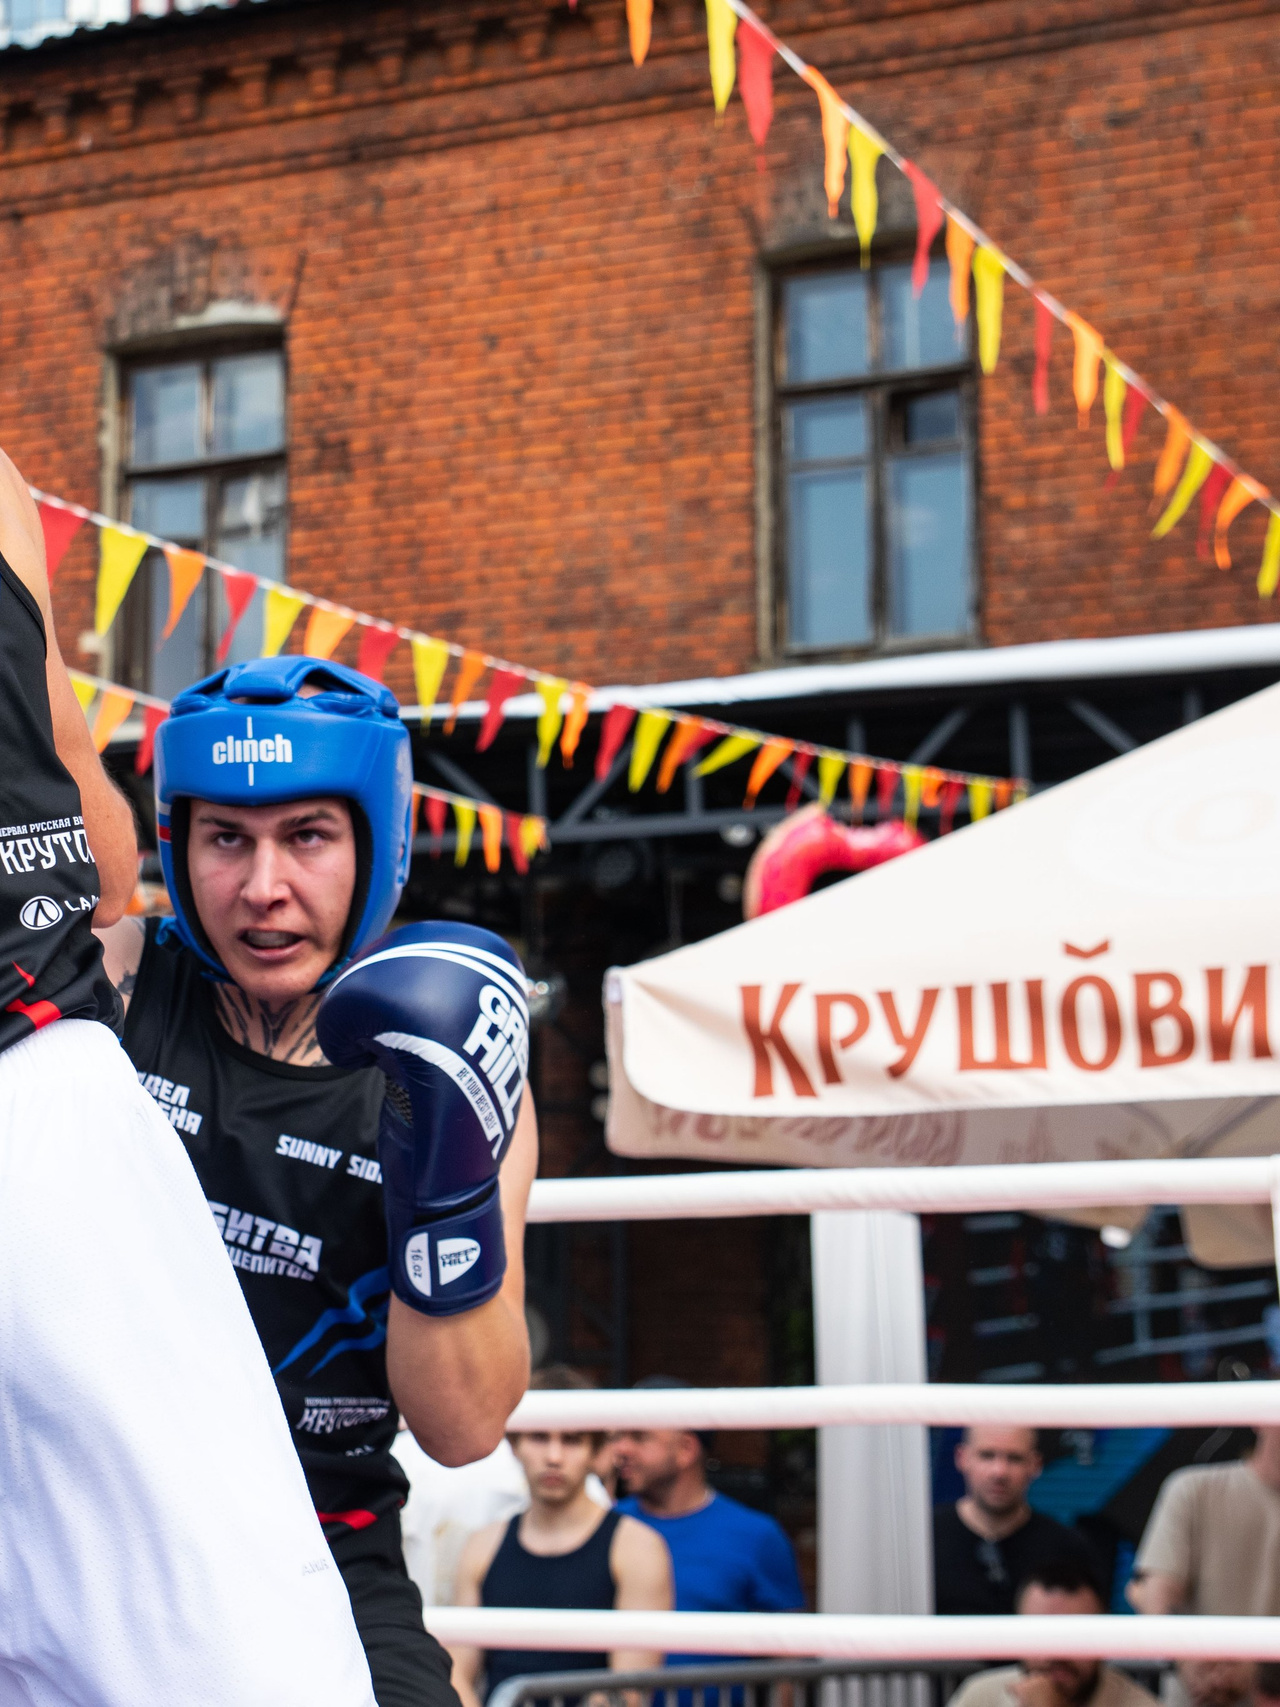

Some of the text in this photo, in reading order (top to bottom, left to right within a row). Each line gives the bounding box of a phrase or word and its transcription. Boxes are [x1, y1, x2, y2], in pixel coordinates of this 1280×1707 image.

[212, 733, 293, 765] clinch
[30, 817, 72, 833] РУССКАЯ
[276, 1134, 383, 1184] SUNNY SID
